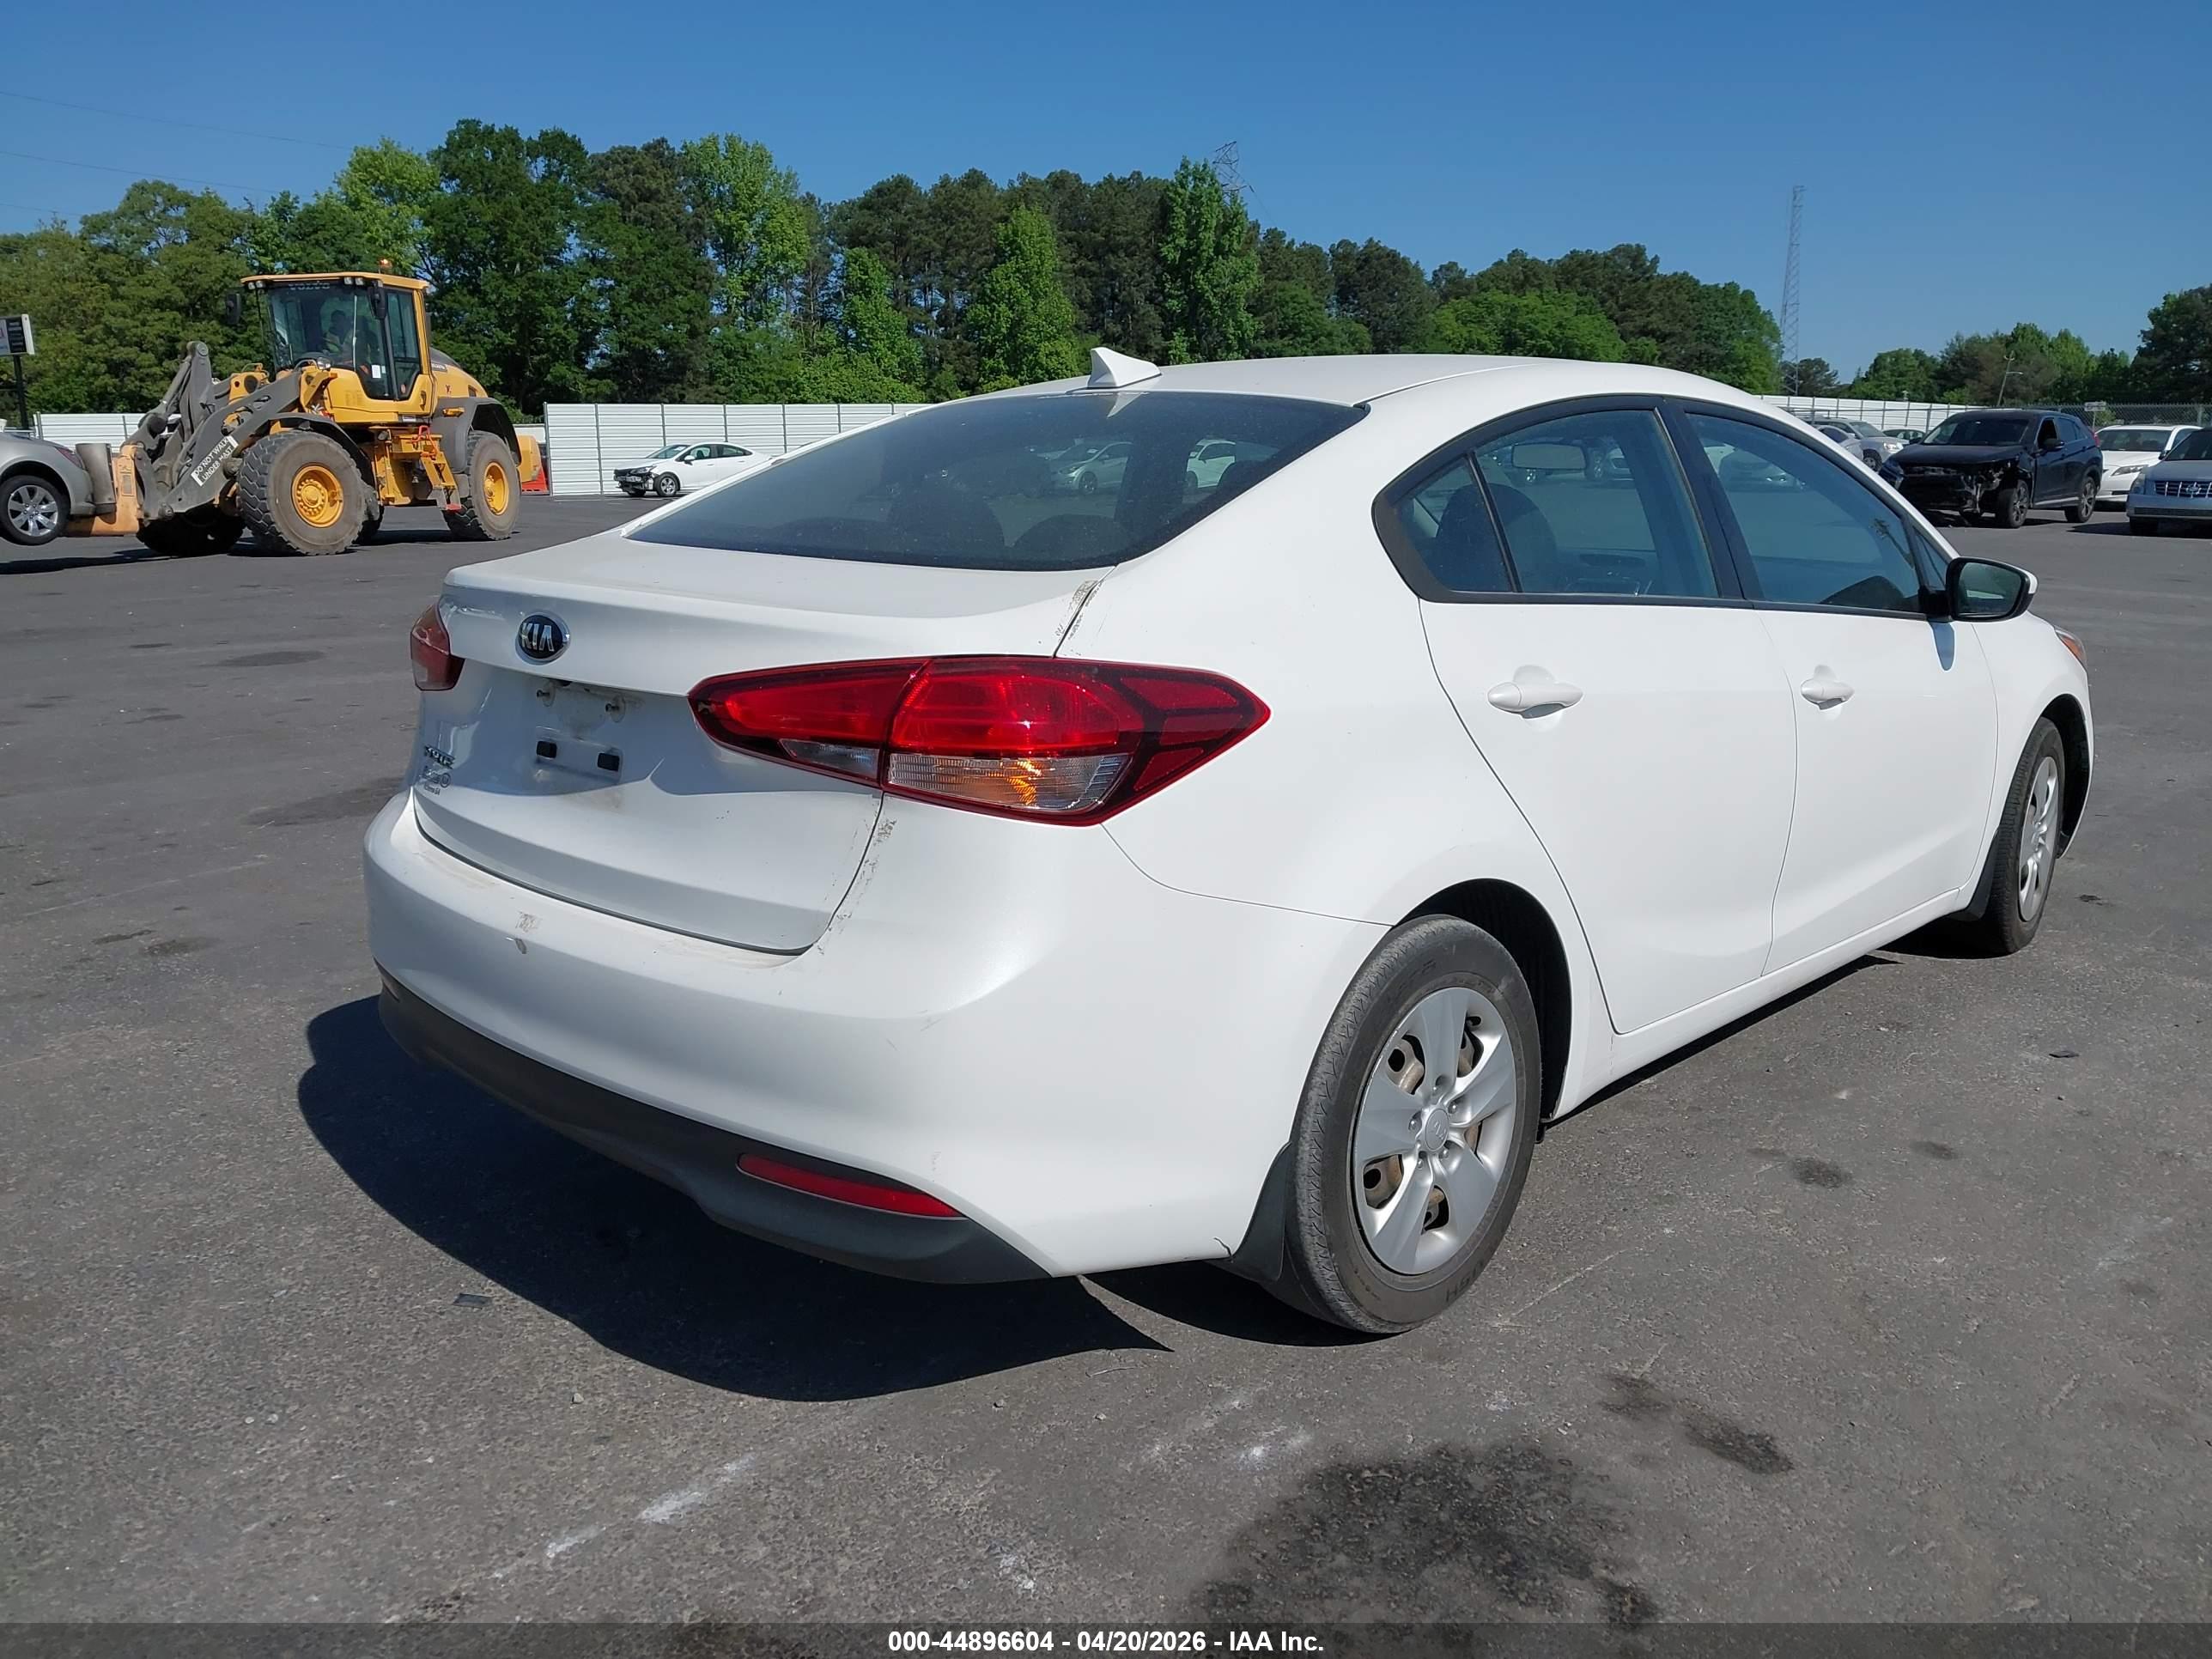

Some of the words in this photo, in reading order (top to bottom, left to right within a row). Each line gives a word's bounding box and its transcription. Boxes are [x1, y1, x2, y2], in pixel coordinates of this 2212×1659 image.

[193, 465, 204, 476] DO
[201, 452, 214, 468] NOT
[213, 437, 229, 454] WALK
[202, 460, 221, 480] UNDER
[218, 445, 233, 461] MAST
[520, 622, 555, 652] KIA
